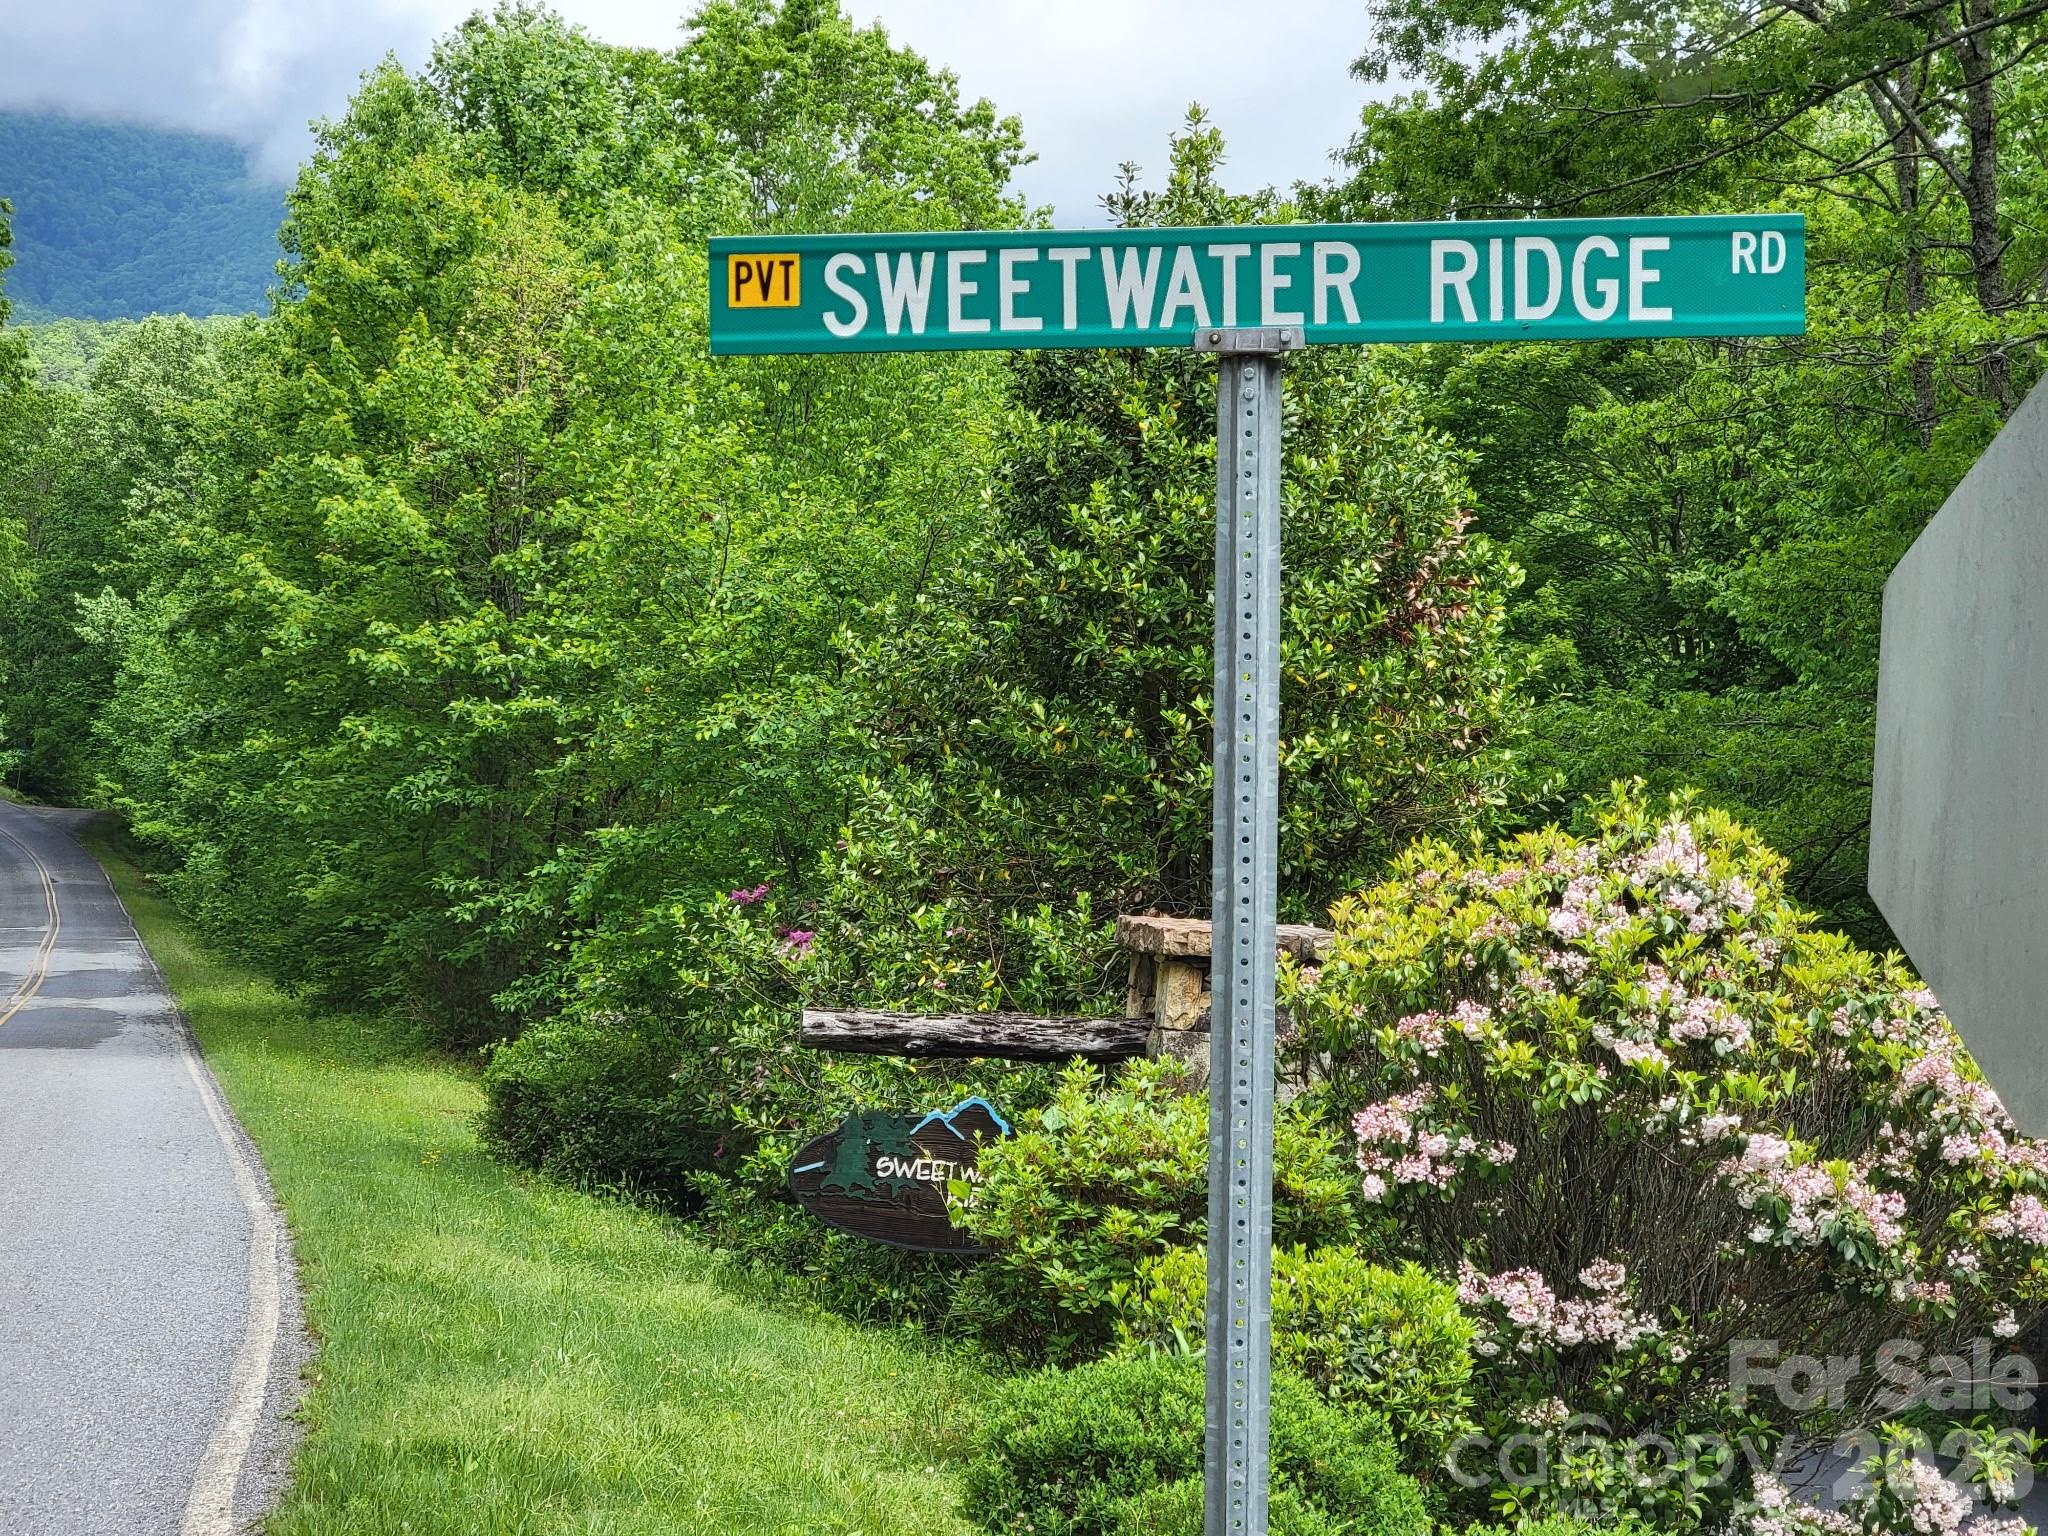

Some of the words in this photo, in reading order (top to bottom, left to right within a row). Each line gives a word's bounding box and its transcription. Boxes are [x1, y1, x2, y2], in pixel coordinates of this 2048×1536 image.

[734, 260, 796, 302] PVT
[822, 241, 1362, 338] SWEETWATER
[1429, 235, 1673, 323] RIDGE
[1731, 231, 1787, 274] RD
[875, 1156, 984, 1184] SWEETW
